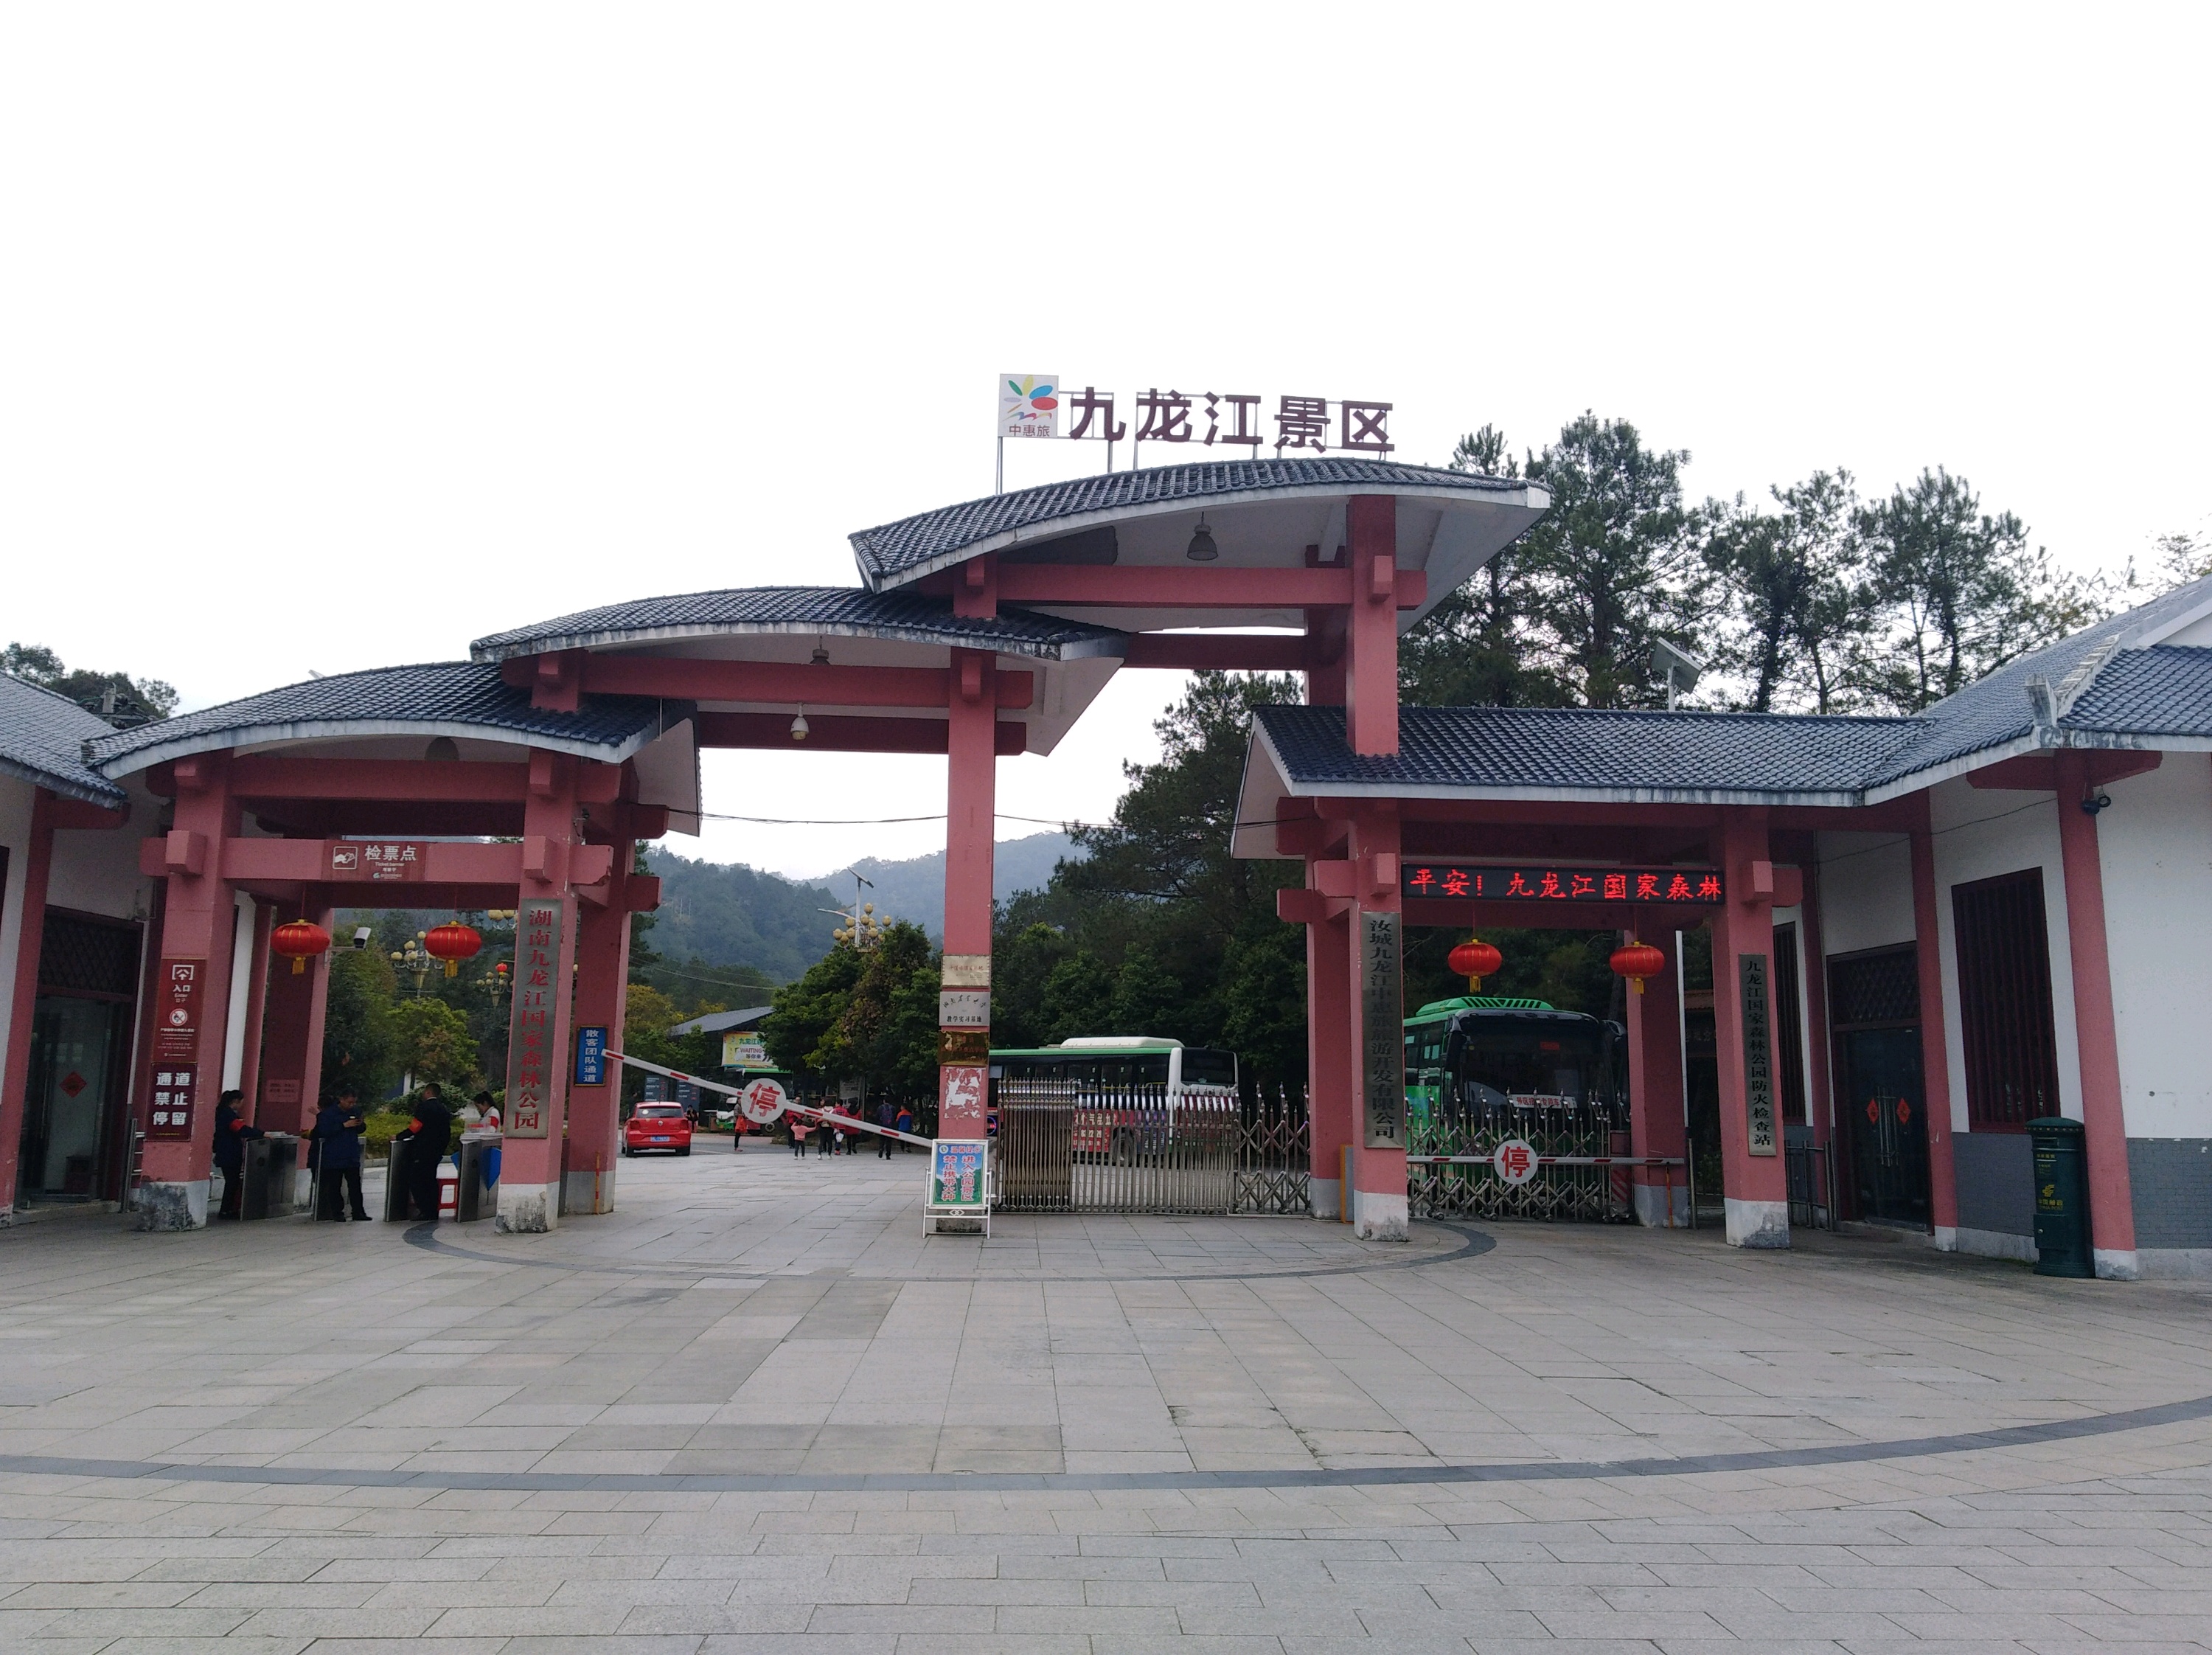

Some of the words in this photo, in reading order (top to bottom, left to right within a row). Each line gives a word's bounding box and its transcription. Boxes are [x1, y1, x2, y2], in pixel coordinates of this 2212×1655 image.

[1008, 425, 1051, 437] 中惠旅
[1068, 386, 1395, 454] 九龙江景区
[364, 844, 417, 861] 检票点
[173, 985, 191, 993] 入口
[515, 909, 552, 1130] 湖南九龙江国家森林公园
[1369, 920, 1395, 1139] 汝城九龙江中惠旅旅游开发有限公司
[582, 1029, 599, 1083] 散客团队通道
[1746, 960, 1771, 1146] 九龙江国家森林公园防火检查站
[156, 1072, 191, 1086] 通道
[154, 1092, 189, 1106] 禁止
[749, 1083, 781, 1117] 停
[153, 1111, 187, 1125] 停留
[950, 1145, 982, 1153] 温馨提示
[1500, 1145, 1531, 1179] 停
[942, 1155, 957, 1201] 禁止携带火种
[961, 1155, 976, 1201] 进入公园景区
